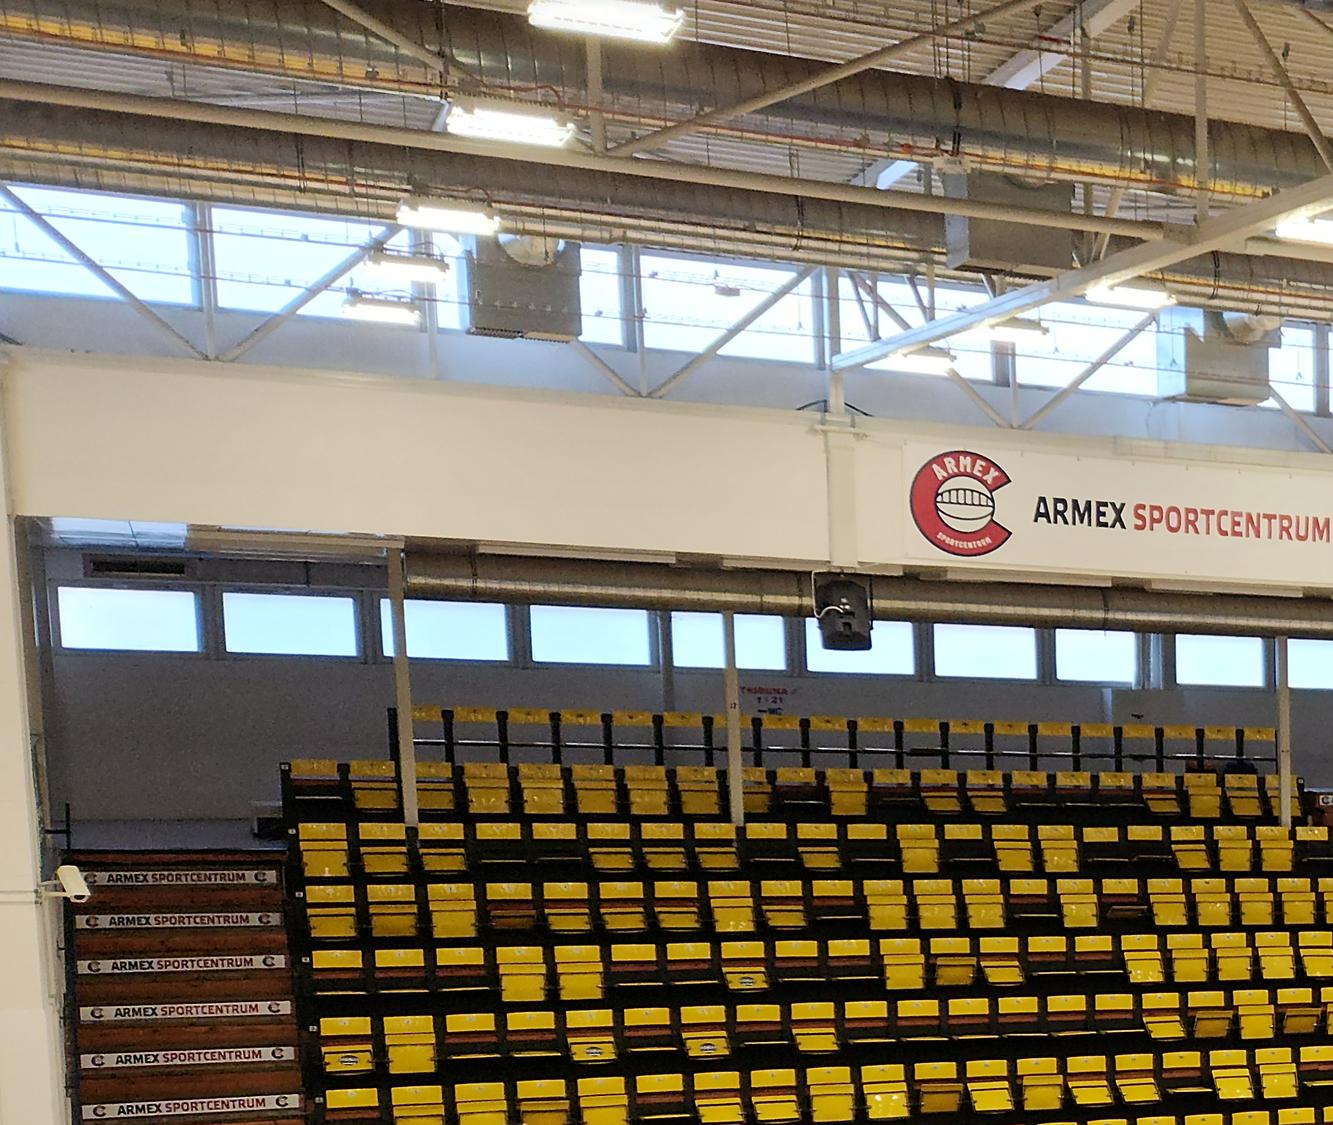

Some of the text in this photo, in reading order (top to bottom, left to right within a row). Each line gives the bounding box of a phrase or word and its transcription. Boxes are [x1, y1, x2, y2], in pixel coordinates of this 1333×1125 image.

[931, 455, 999, 486] ARMEX
[1034, 496, 1331, 544] ARMEX SPORTCENTRUM
[107, 872, 246, 883] ARMEX SPORTCENTRUM
[109, 915, 250, 926] ARMEX SPORTCENTRUM
[111, 958, 253, 972] ARMEX SPORTCENTRUM
[114, 1004, 259, 1018] ARMEX SPORTCENTRUM
[116, 1050, 262, 1065] ARMEX SPORTCENTRUM
[118, 1098, 266, 1116] ARMEX SPORTCENTRUM
